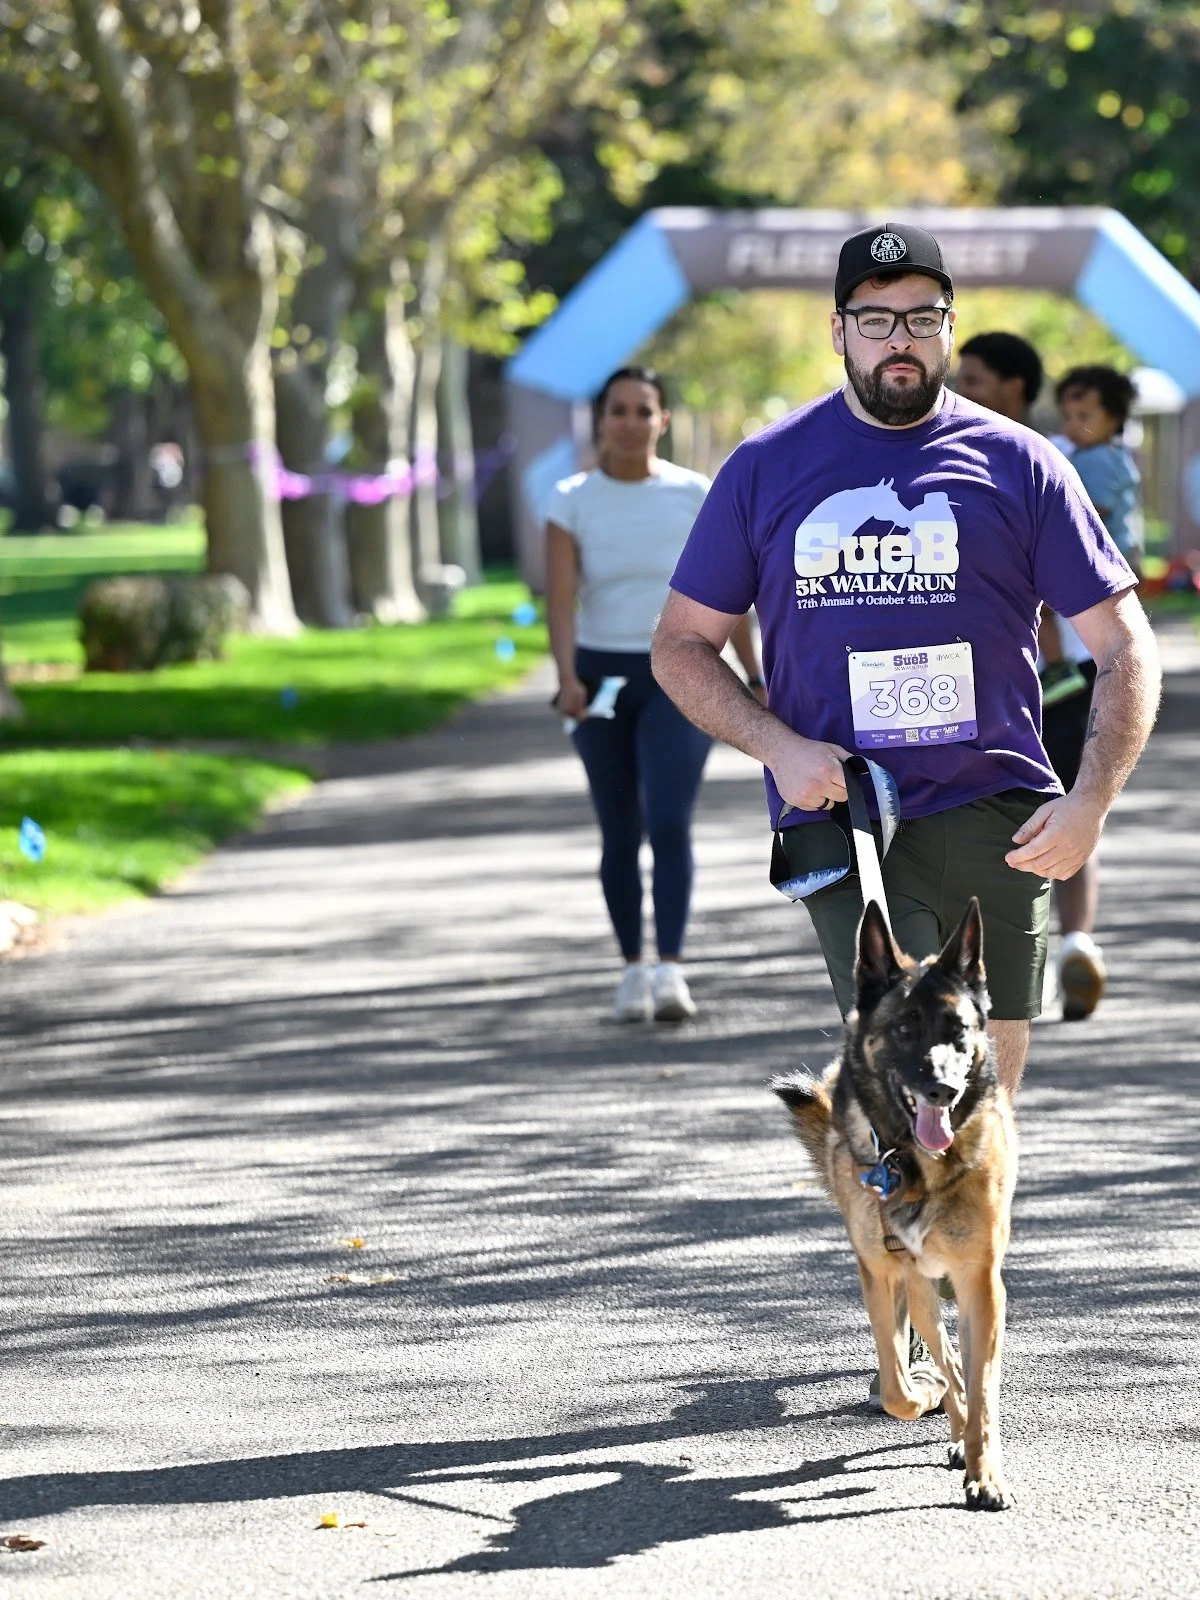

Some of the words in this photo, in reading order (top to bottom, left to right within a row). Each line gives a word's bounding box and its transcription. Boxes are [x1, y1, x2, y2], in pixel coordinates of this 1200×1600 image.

[794, 520, 959, 578] SueB
[795, 577, 827, 597] 5K
[829, 573, 956, 594] WALK/RUN
[796, 598, 819, 610] 17th
[820, 595, 855, 607] Annual
[866, 594, 905, 606] October
[907, 593, 929, 605] 4th,
[929, 593, 956, 604] 2026
[893, 652, 928, 666] SueB
[869, 674, 959, 718] 368
